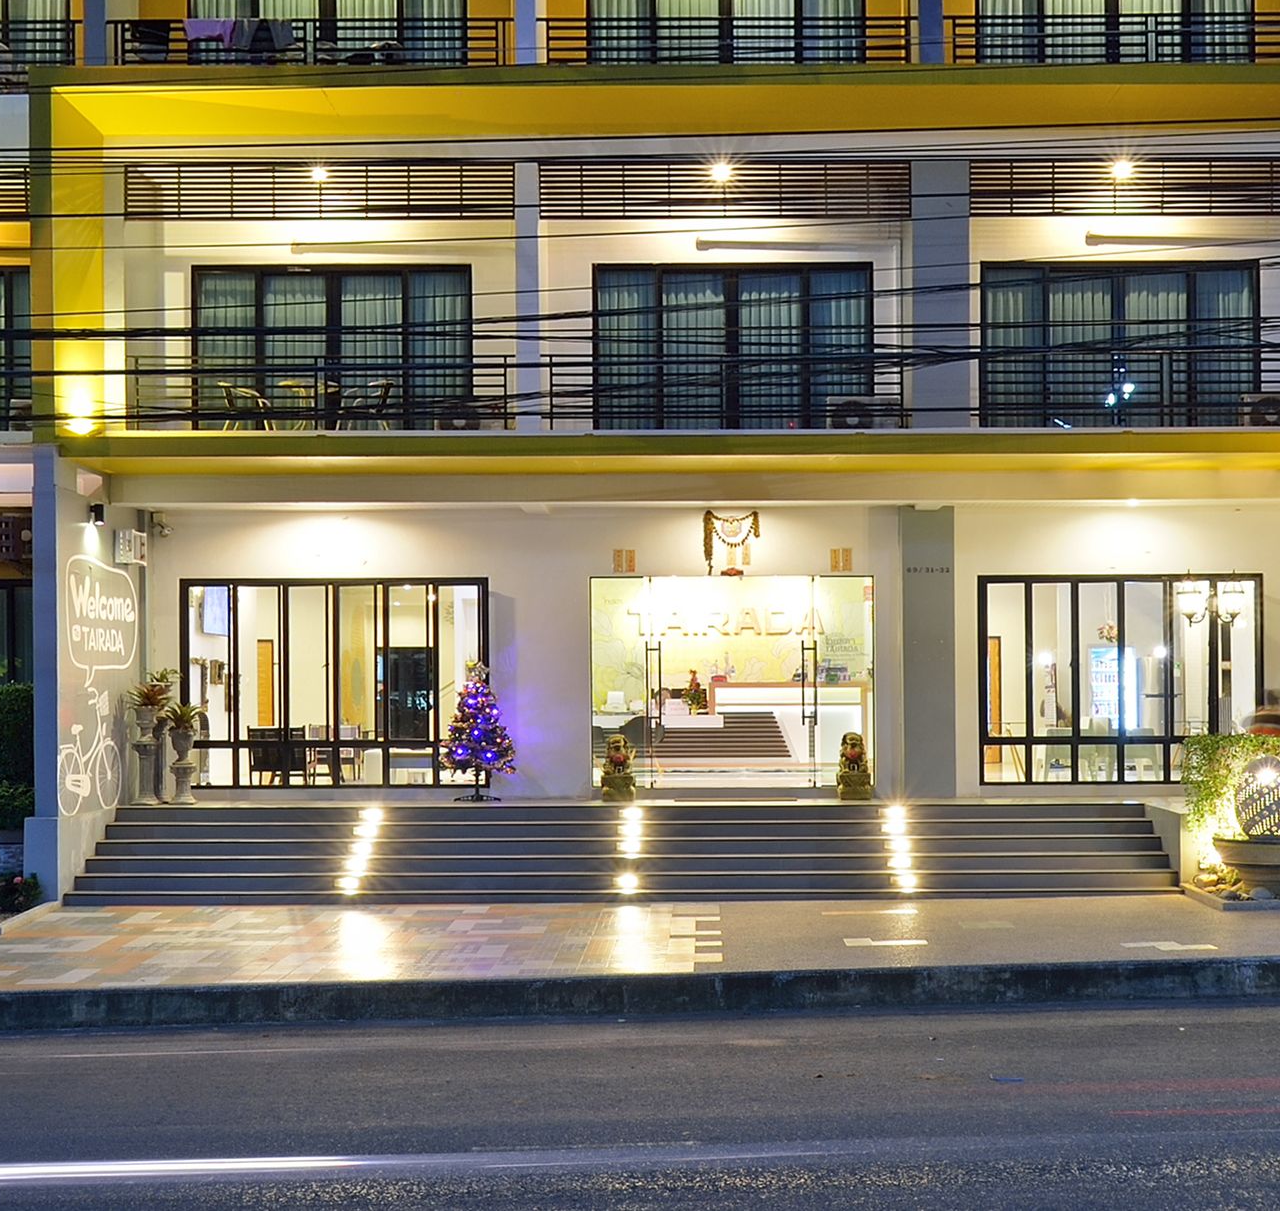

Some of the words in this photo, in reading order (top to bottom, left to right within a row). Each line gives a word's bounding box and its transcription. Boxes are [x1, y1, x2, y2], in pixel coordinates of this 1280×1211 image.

[70, 574, 135, 623] Welcome
[627, 606, 825, 636] TAIRADA
[82, 626, 125, 656] TAIRADA
